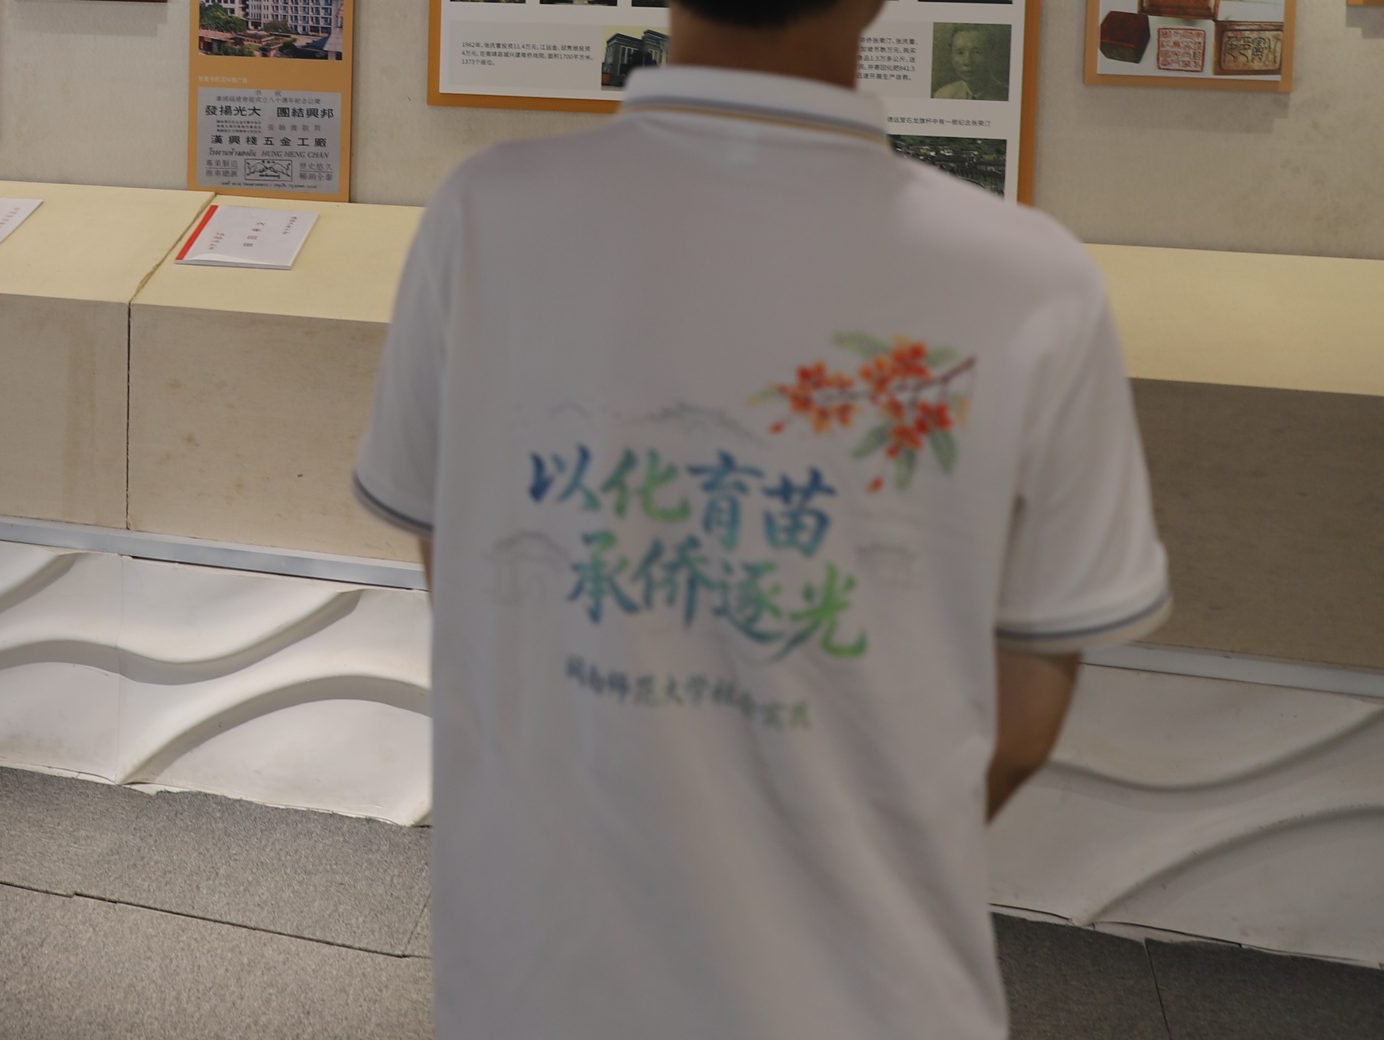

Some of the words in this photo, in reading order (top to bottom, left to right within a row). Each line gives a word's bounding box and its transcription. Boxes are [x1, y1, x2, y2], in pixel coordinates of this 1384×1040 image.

[205, 105, 262, 117] 發揚光大
[276, 106, 334, 119] 團結興邦
[526, 445, 837, 557] 以化育苗
[566, 529, 868, 666] 承侨逐光
